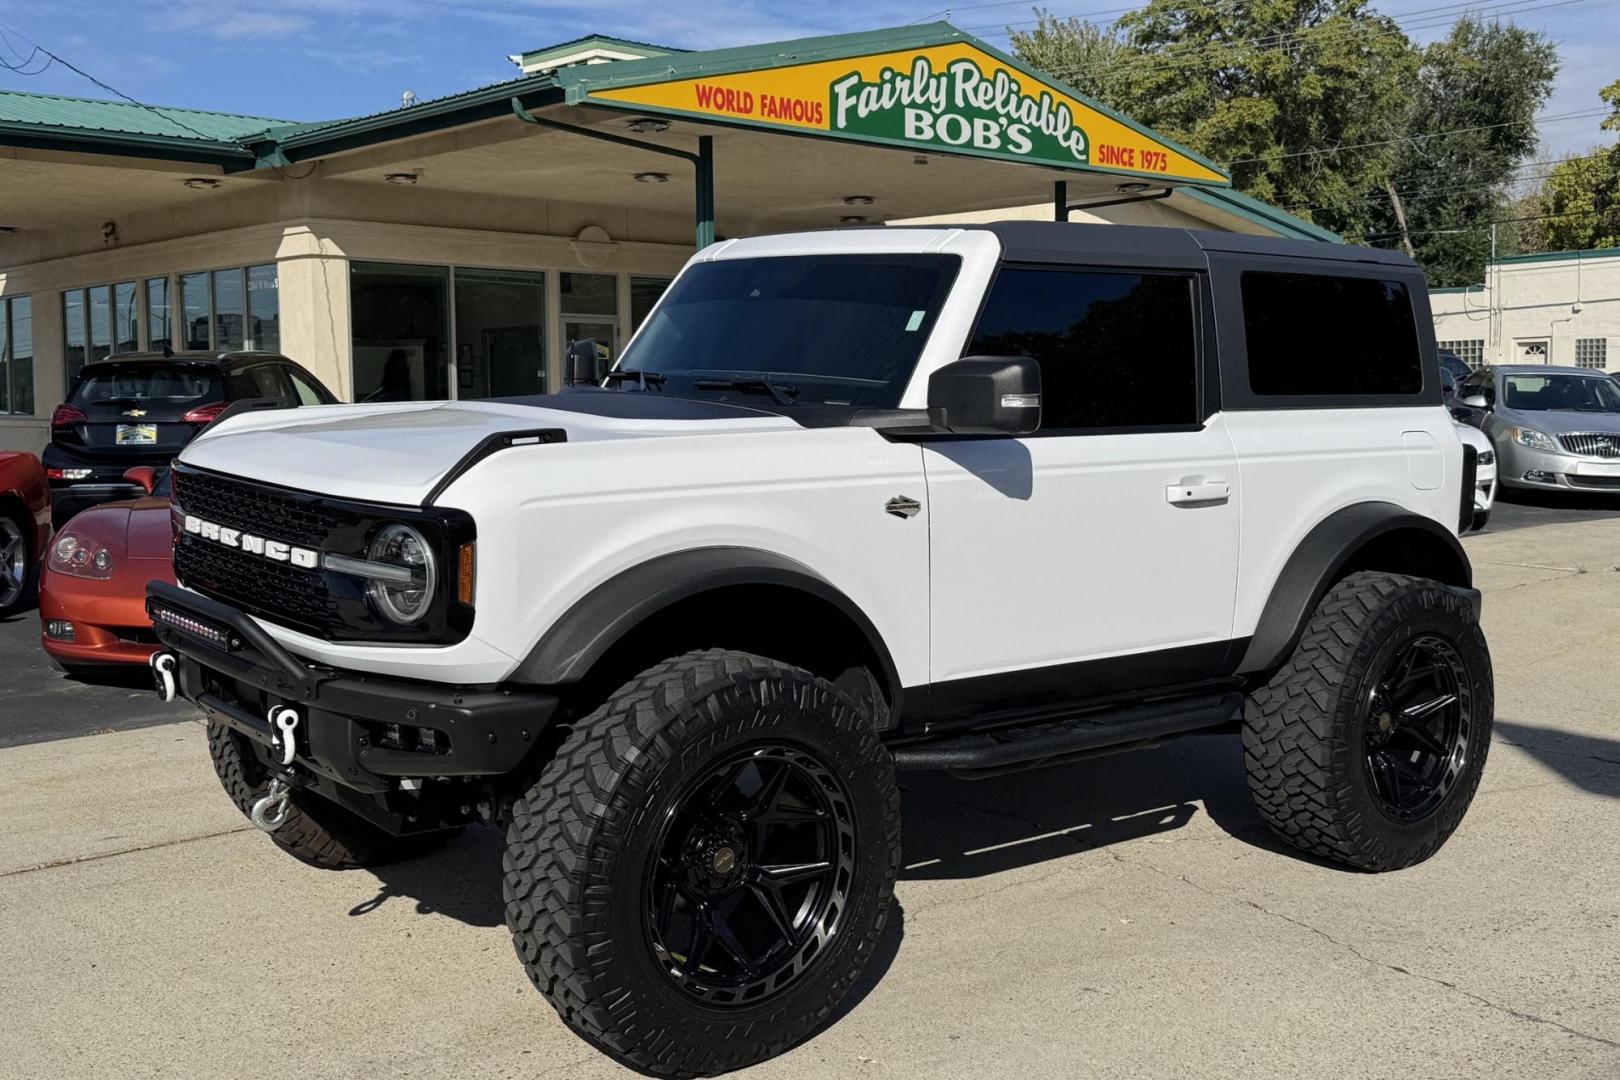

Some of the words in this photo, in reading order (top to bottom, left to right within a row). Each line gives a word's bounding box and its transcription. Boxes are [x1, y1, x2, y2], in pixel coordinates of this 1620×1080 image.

[695, 83, 754, 115] WORLD
[760, 93, 823, 124] FAMOUS
[834, 59, 948, 129] Fairly
[950, 61, 1087, 160] Reliable
[904, 107, 1033, 154] BOB'S
[1098, 143, 1135, 168] SINCE
[1140, 149, 1168, 172] 1975
[184, 515, 318, 569] BRONCO
